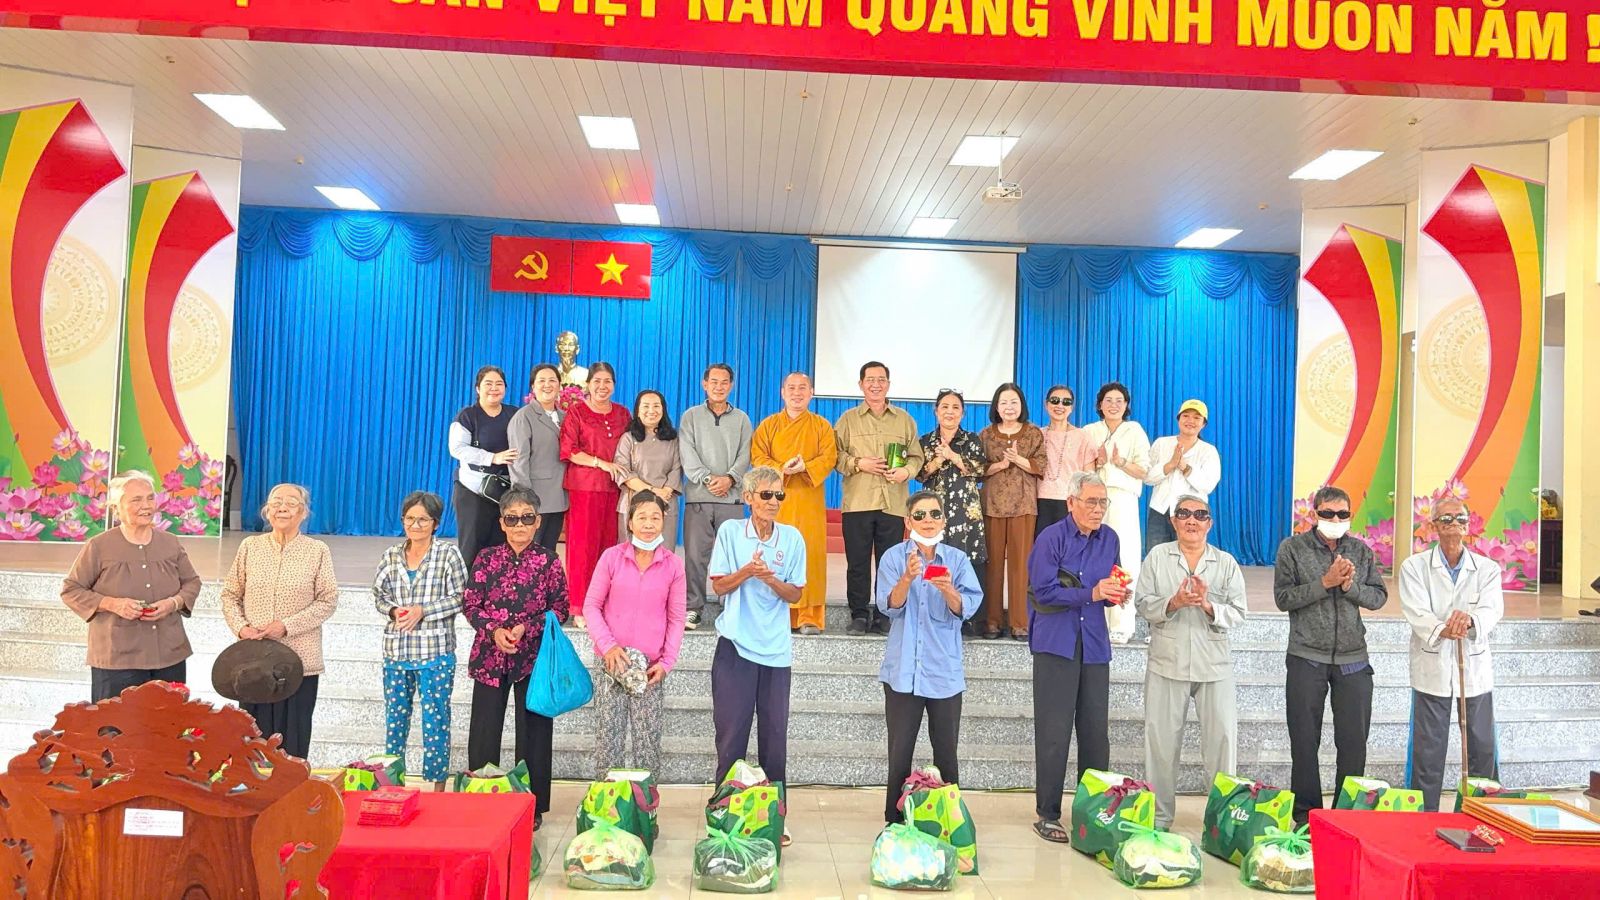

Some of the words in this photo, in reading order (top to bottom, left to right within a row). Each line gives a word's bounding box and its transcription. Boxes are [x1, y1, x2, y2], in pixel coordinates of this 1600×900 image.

[847, 0, 1049, 37] QUANG
[1073, 0, 1212, 44] VINH
[1435, 0, 1567, 61] NĂM
[1587, 14, 1600, 63] !
